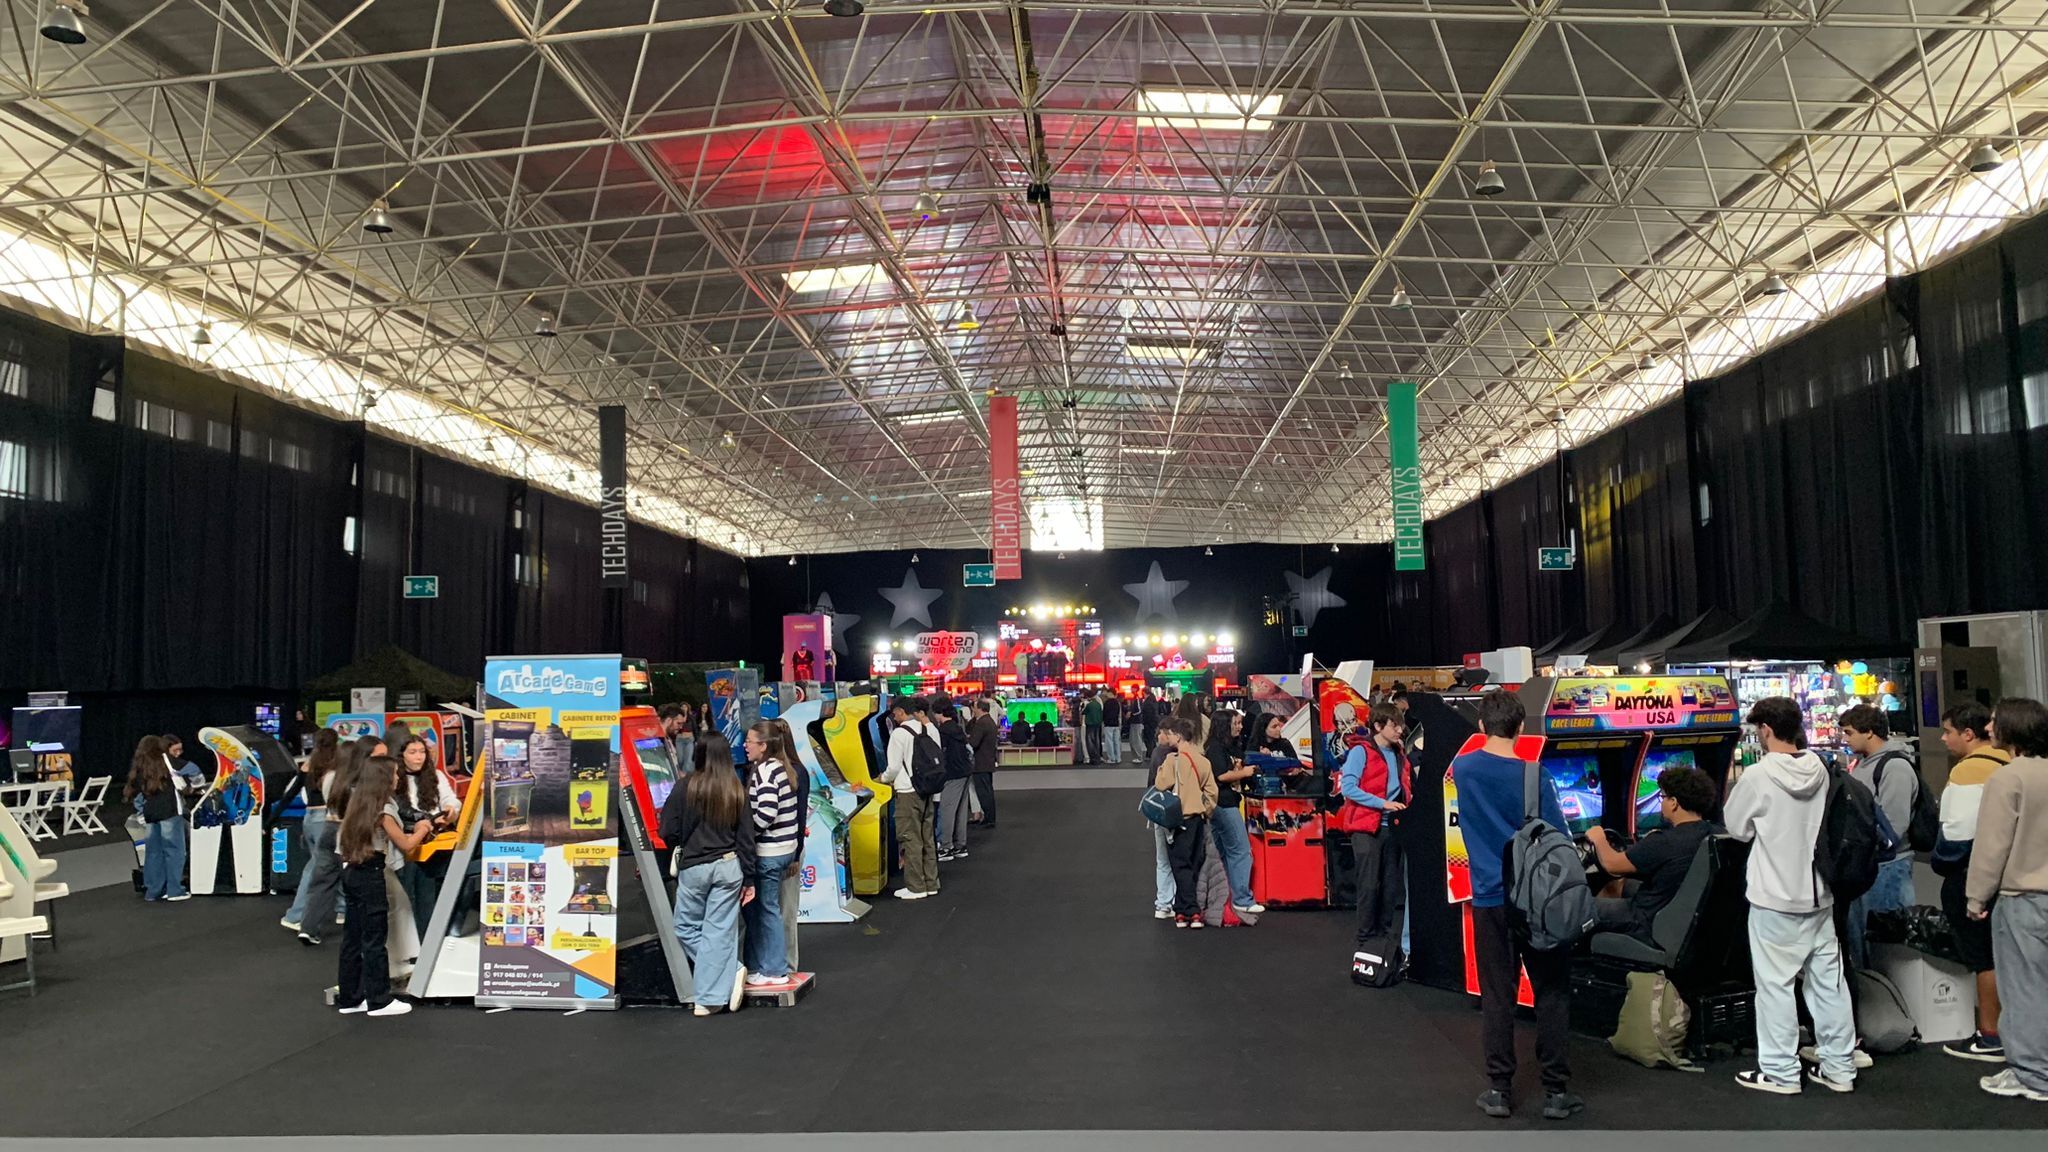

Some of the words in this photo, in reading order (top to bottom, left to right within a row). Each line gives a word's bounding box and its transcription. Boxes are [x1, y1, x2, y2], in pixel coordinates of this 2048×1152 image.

[1393, 467, 1422, 561] TECHDAYS
[993, 478, 1019, 570] TECHDAYS
[602, 486, 626, 579] TECHDAYS
[1615, 695, 1674, 711] DAYTONA
[499, 712, 537, 720] CABINET
[1646, 711, 1676, 725] USA
[1694, 714, 1710, 724] RACE
[1551, 719, 1569, 729] RACE
[272, 828, 288, 874] SEGA
[1353, 962, 1374, 976] FILA
